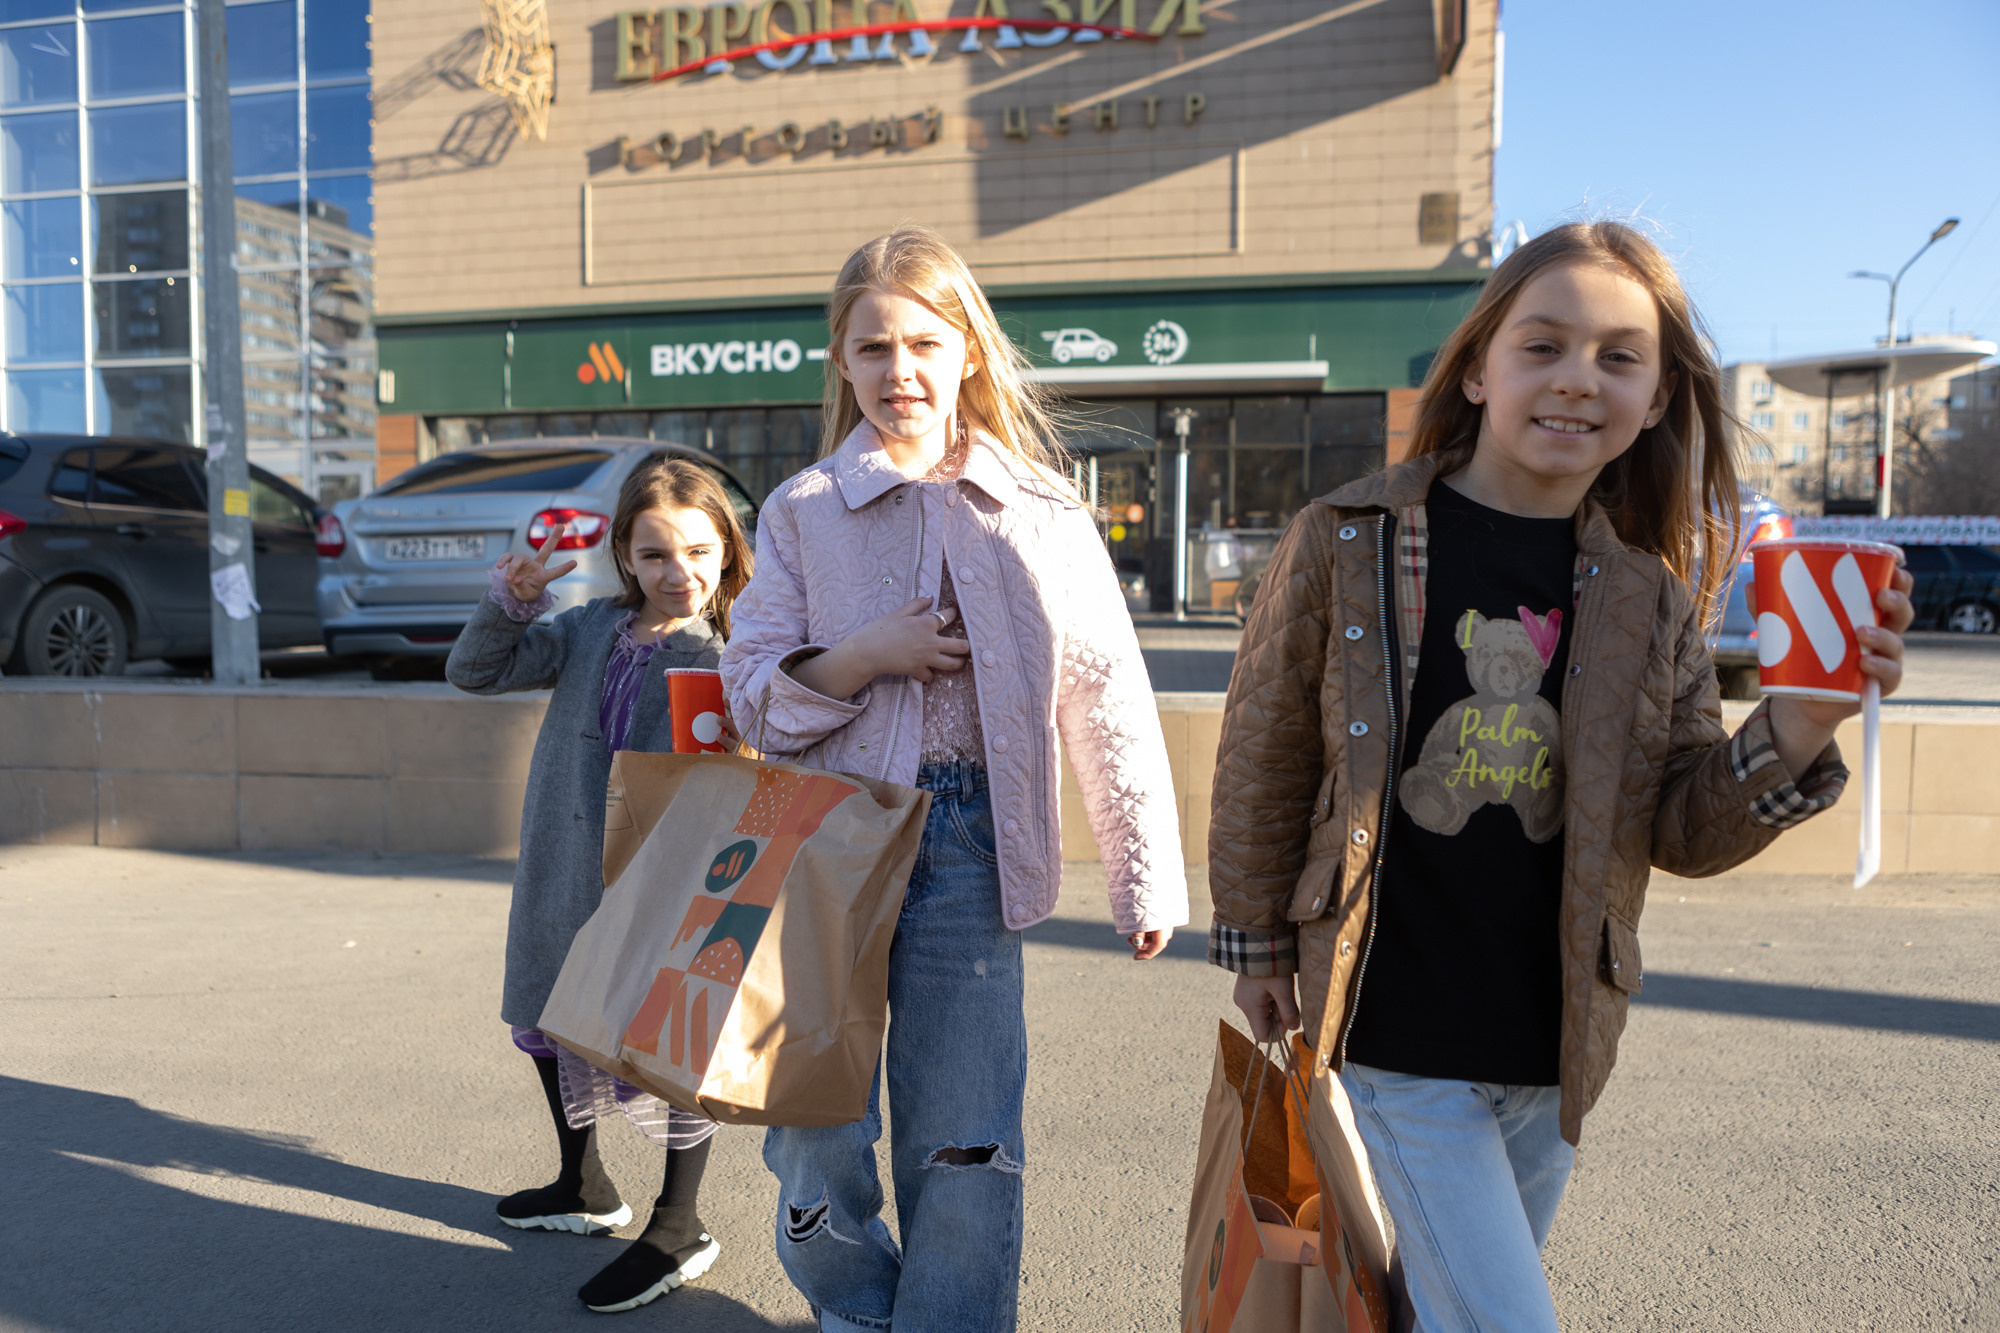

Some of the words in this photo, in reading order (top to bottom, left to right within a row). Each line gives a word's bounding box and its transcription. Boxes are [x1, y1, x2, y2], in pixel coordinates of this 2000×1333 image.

[616, 104, 944, 168] ТОРГОВЫЙ
[1003, 92, 1206, 141] ЦЕНТР
[650, 338, 803, 377] ВКУСНО
[1460, 608, 1478, 649] I
[1459, 703, 1544, 748] Palm
[1445, 746, 1555, 800] Angels
